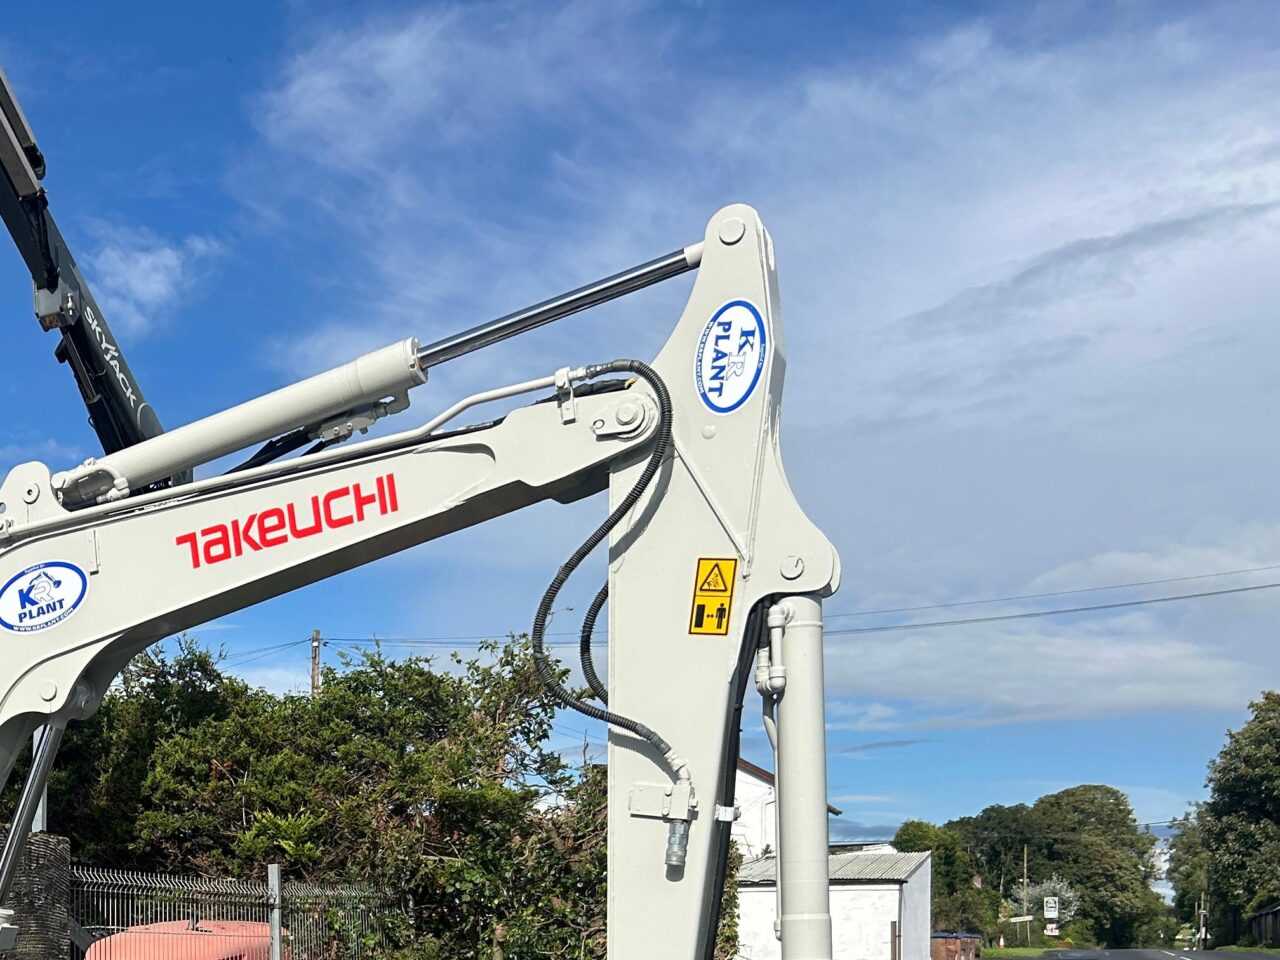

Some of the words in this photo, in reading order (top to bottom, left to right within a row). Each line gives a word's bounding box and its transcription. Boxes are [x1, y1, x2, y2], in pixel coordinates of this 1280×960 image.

[84, 306, 137, 408] SKYJACK
[708, 320, 733, 398] PLANT
[18, 580, 55, 610] KR
[18, 598, 65, 623] PLANT
